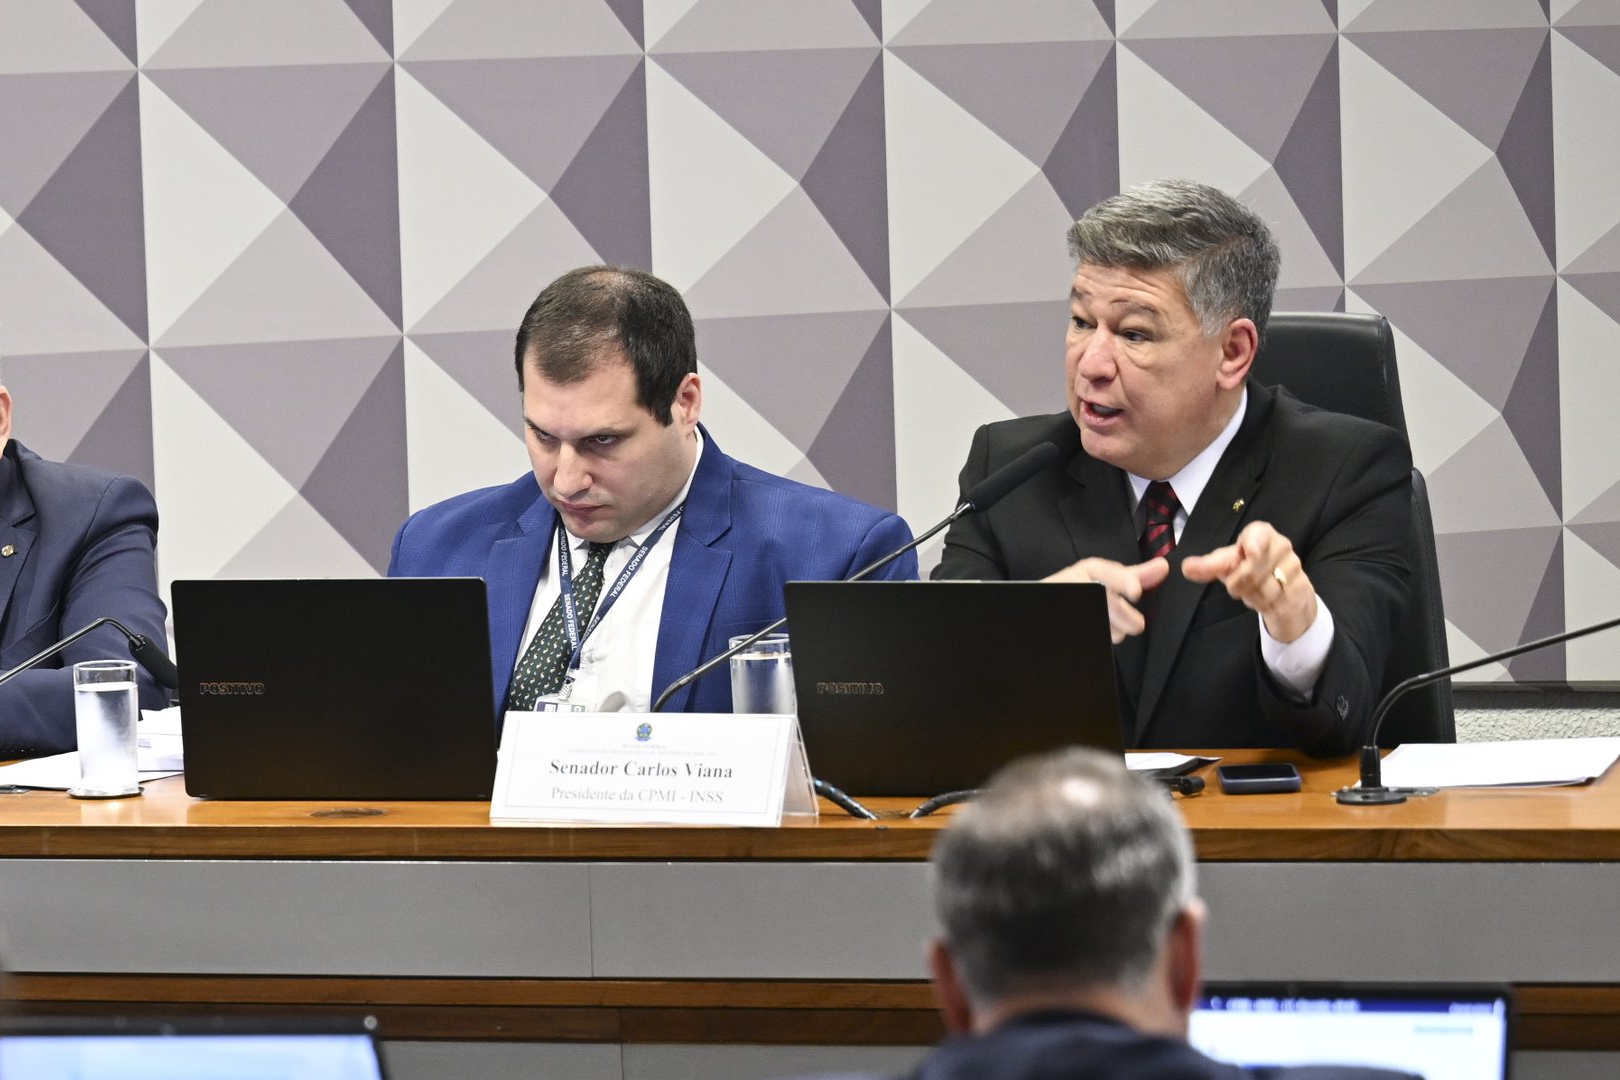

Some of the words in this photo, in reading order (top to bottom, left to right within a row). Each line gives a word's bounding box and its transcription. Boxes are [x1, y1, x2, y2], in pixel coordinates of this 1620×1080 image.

[561, 551, 569, 577] FEDERAL
[628, 545, 648, 571] SENADO
[609, 570, 631, 598] FEDERAL
[564, 593, 573, 619] SENADO
[568, 618, 578, 650] FEDERAL
[199, 682, 266, 695] POSITIVO
[816, 682, 884, 695] POSITIVO
[549, 760, 618, 776] Senador
[624, 761, 678, 777] Carlos
[684, 762, 733, 779] Viana
[551, 786, 616, 801] Presidente
[619, 787, 634, 801] da
[638, 788, 676, 802] CPMI
[690, 789, 724, 804] INSS
